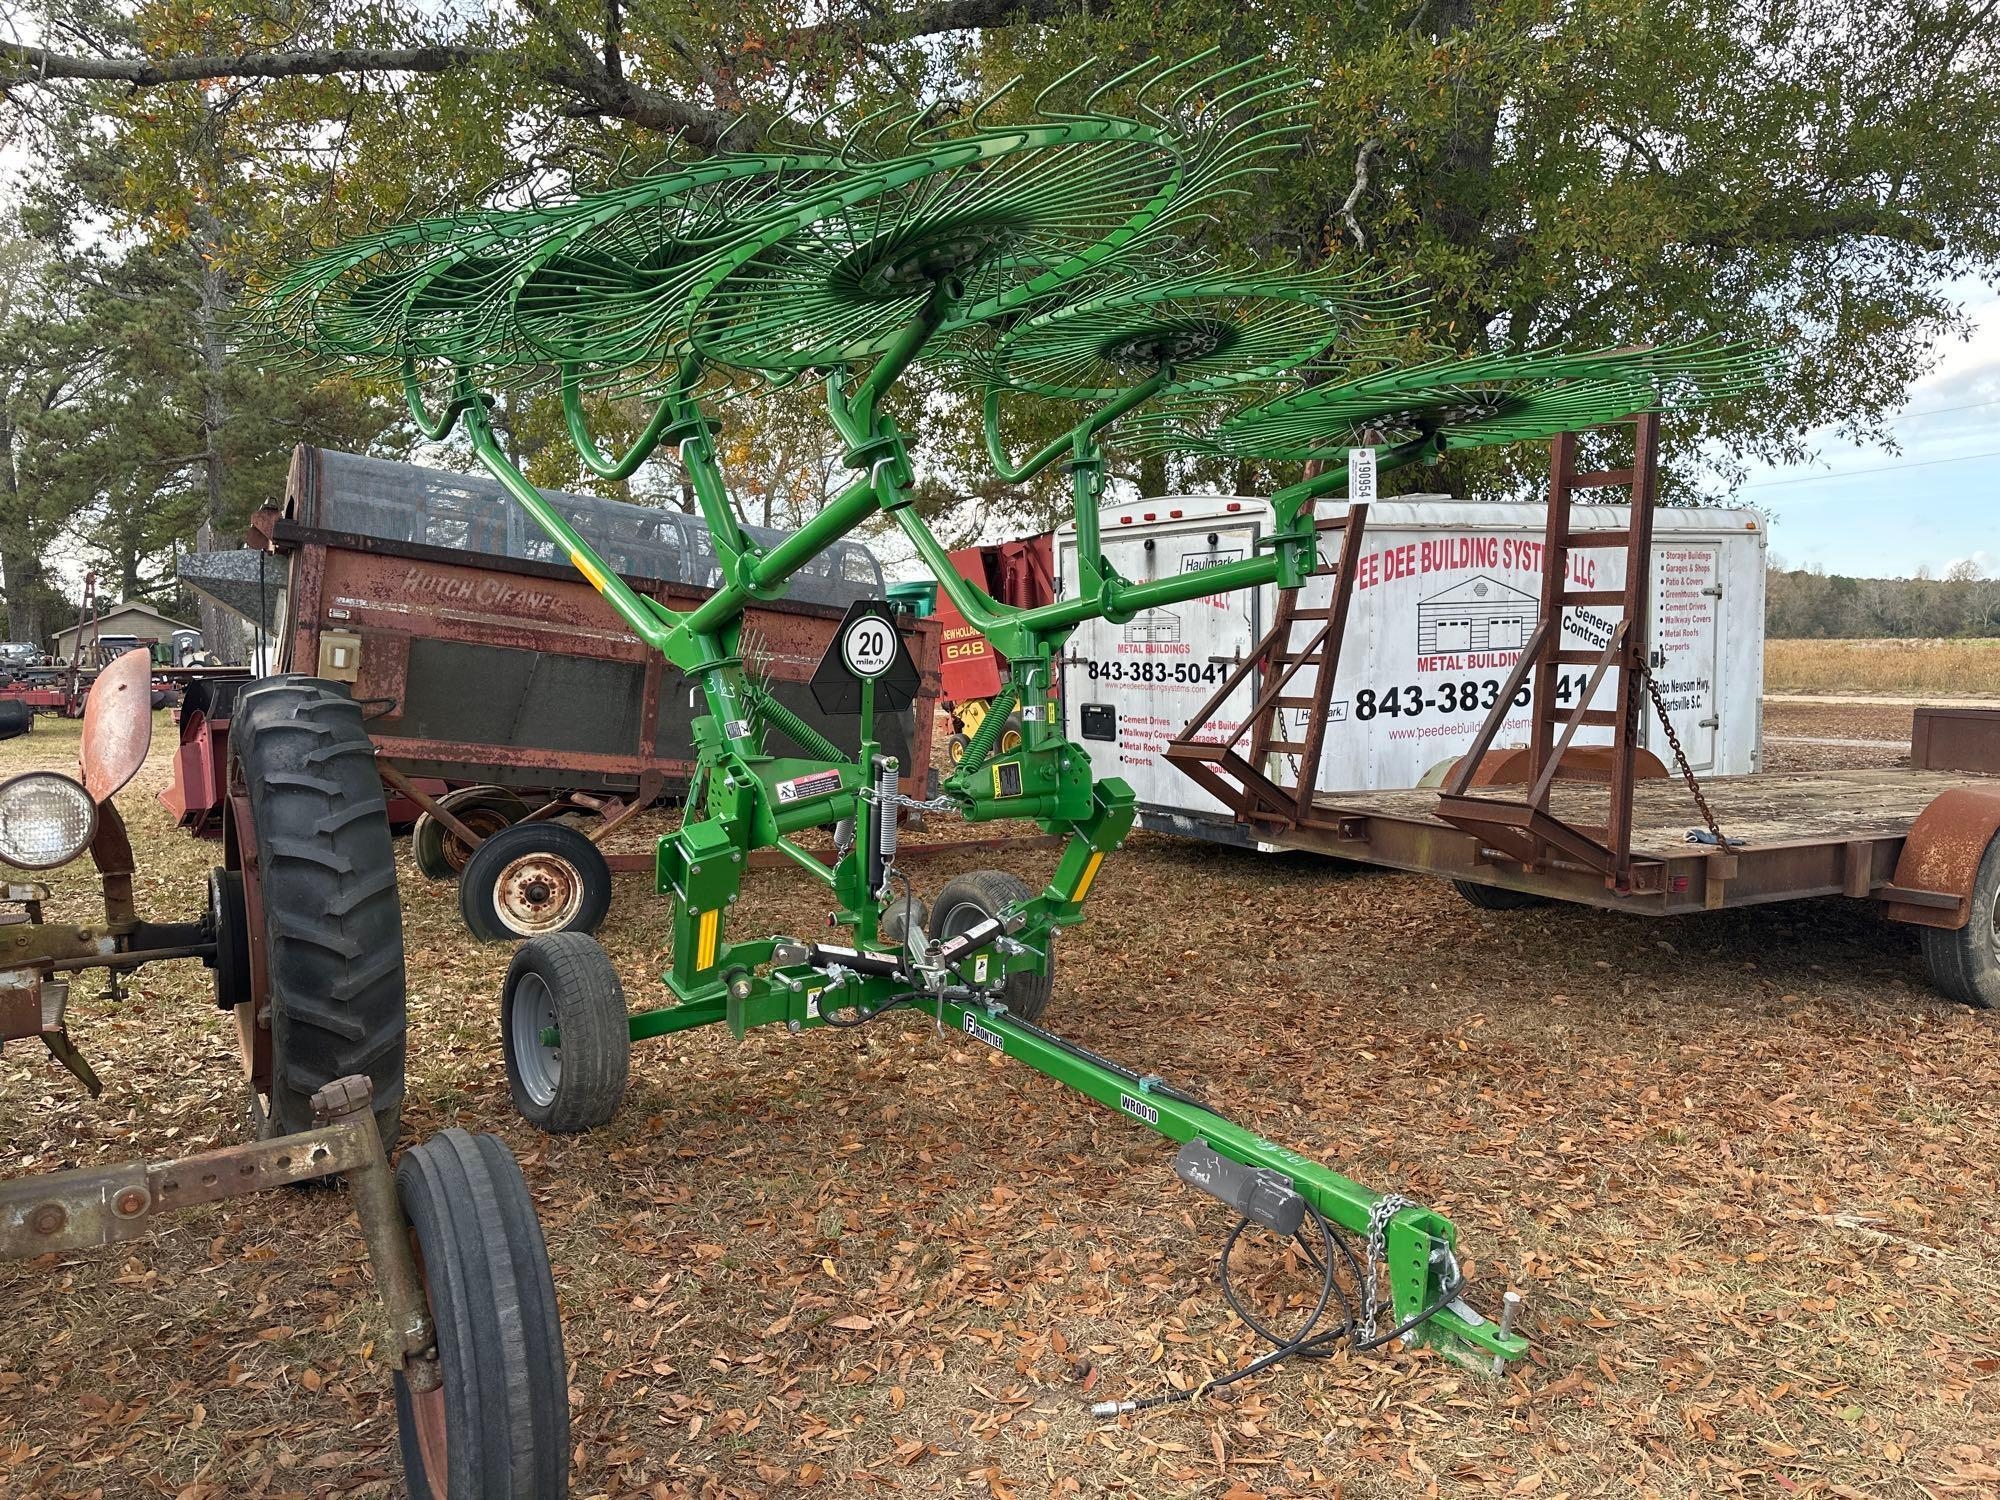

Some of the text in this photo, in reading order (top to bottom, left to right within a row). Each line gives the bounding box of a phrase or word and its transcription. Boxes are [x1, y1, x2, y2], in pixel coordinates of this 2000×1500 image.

[1358, 460, 1371, 498] 190954
[1666, 551, 1712, 561] Storage Buildings
[1383, 543, 1416, 583] DEE
[1420, 536, 1499, 574] BUILDING
[1573, 553, 1596, 589] LLC
[1665, 564, 1710, 574] Garages & Shops
[1665, 577, 1704, 586] Patio & Covers
[1665, 590, 1699, 598] Greenhouses
[1665, 602, 1707, 611] Cement Drives
[1664, 615, 1712, 626] Walkway Covers
[1664, 628, 1699, 637] Metal Roofs
[858, 631, 883, 656] 20
[1117, 643, 1191, 655] METAL BUILDINGS
[1664, 643, 1690, 653] Carports
[946, 641, 984, 659] 648
[856, 658, 884, 666] mile/h
[1417, 651, 1524, 673] METAL BUILDIN
[1088, 661, 1228, 685] 843-383-5041
[1104, 682, 1206, 694] www.peedeebuildingsystems.com
[1670, 678, 1696, 692] Newsom
[1696, 677, 1710, 694] Hwy.
[1355, 673, 1587, 721] 843-383541
[1662, 694, 1703, 712] Hartsville S.C.
[1123, 714, 1171, 726] Cement Drives
[1123, 727, 1177, 740] Walkway Covers
[1123, 742, 1163, 753] Metal Roofs
[1124, 755, 1153, 767] Carports
[965, 1012, 1003, 1049] FRONTIER
[1121, 1094, 1157, 1124] WR0010
